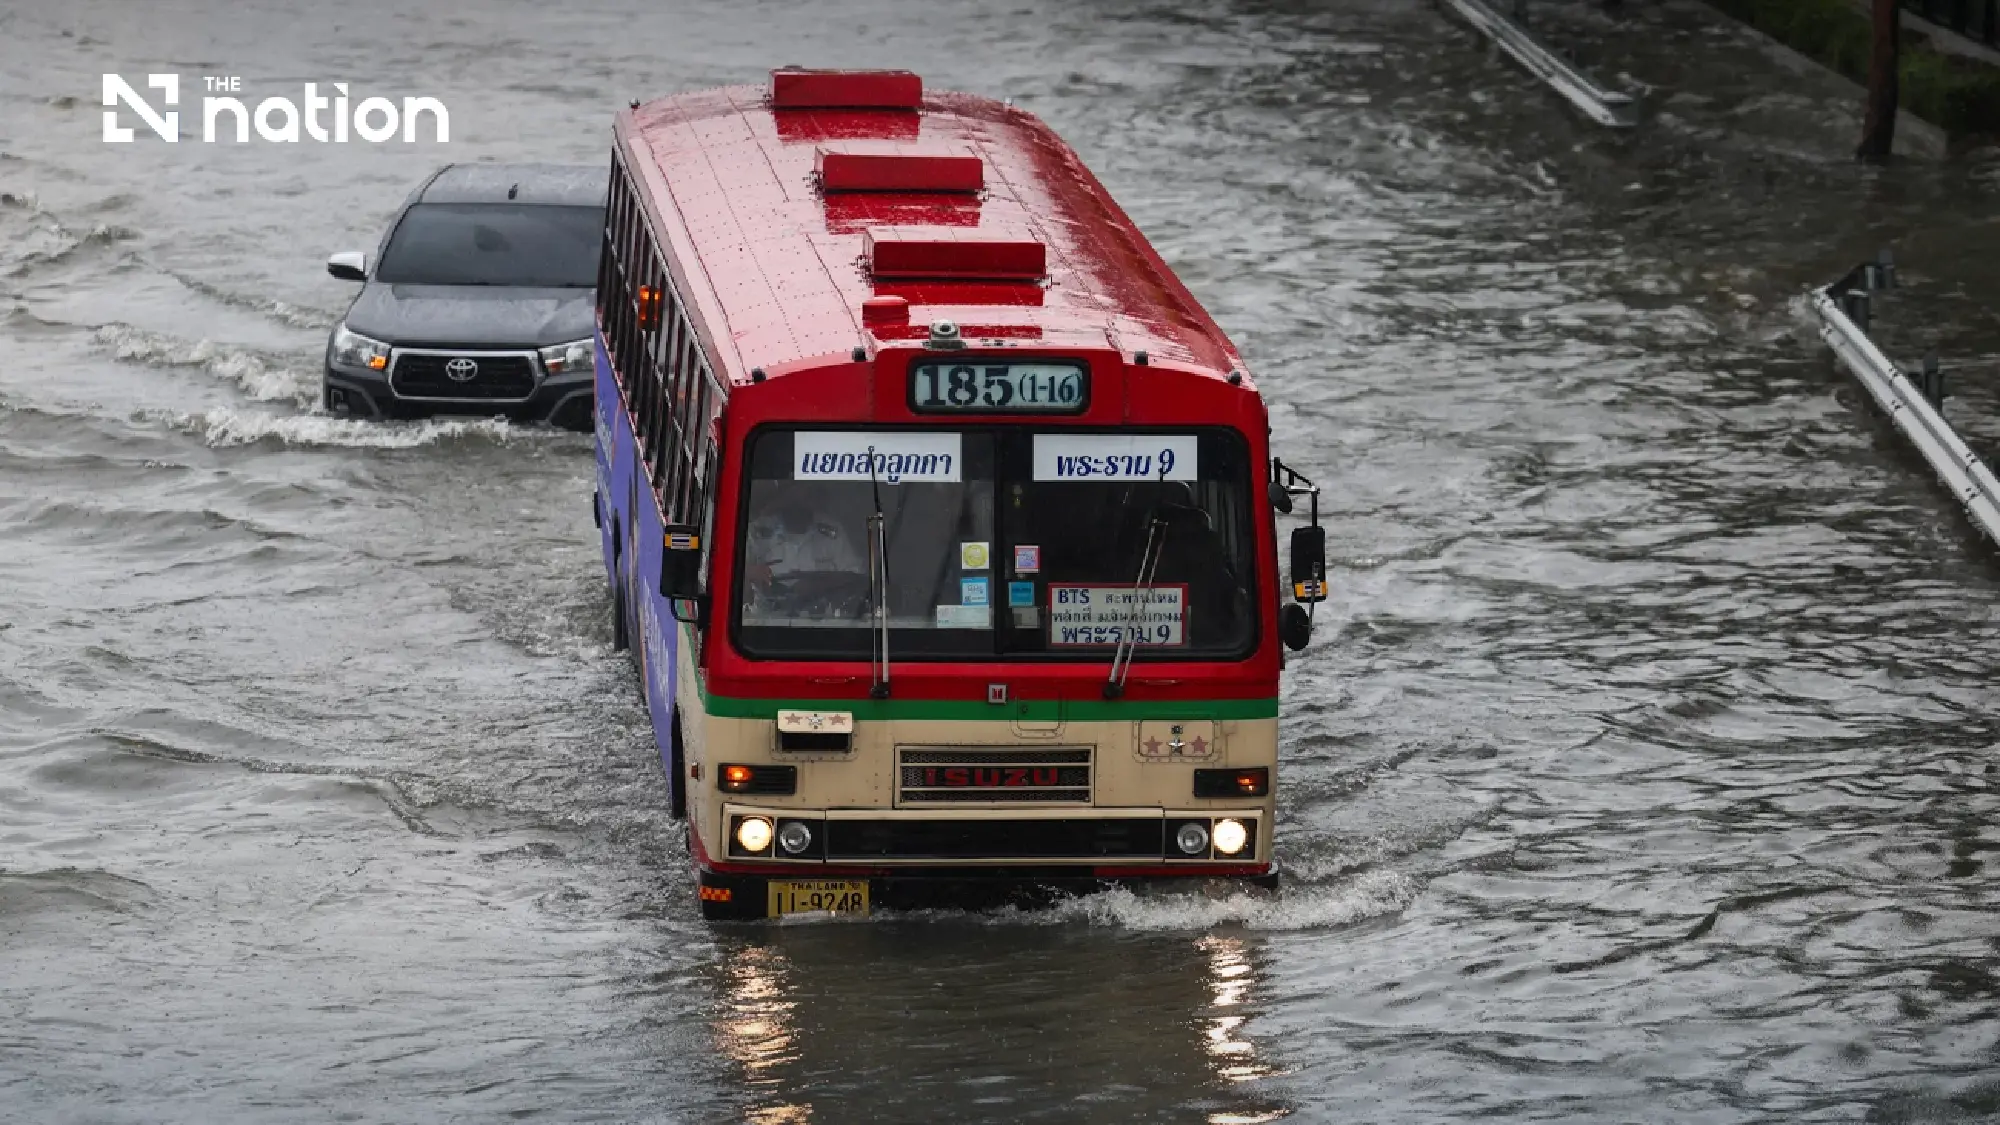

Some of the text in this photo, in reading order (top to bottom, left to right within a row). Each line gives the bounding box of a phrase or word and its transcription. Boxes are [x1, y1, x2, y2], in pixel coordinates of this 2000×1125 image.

[922, 365, 1083, 407] 185 (1-16)
[1057, 455, 1152, 477] พระราม
[1057, 588, 1091, 604] BTS
[1156, 624, 1171, 644] 9
[925, 766, 1060, 787] ISUZU
[790, 882, 846, 891] THAILAND
